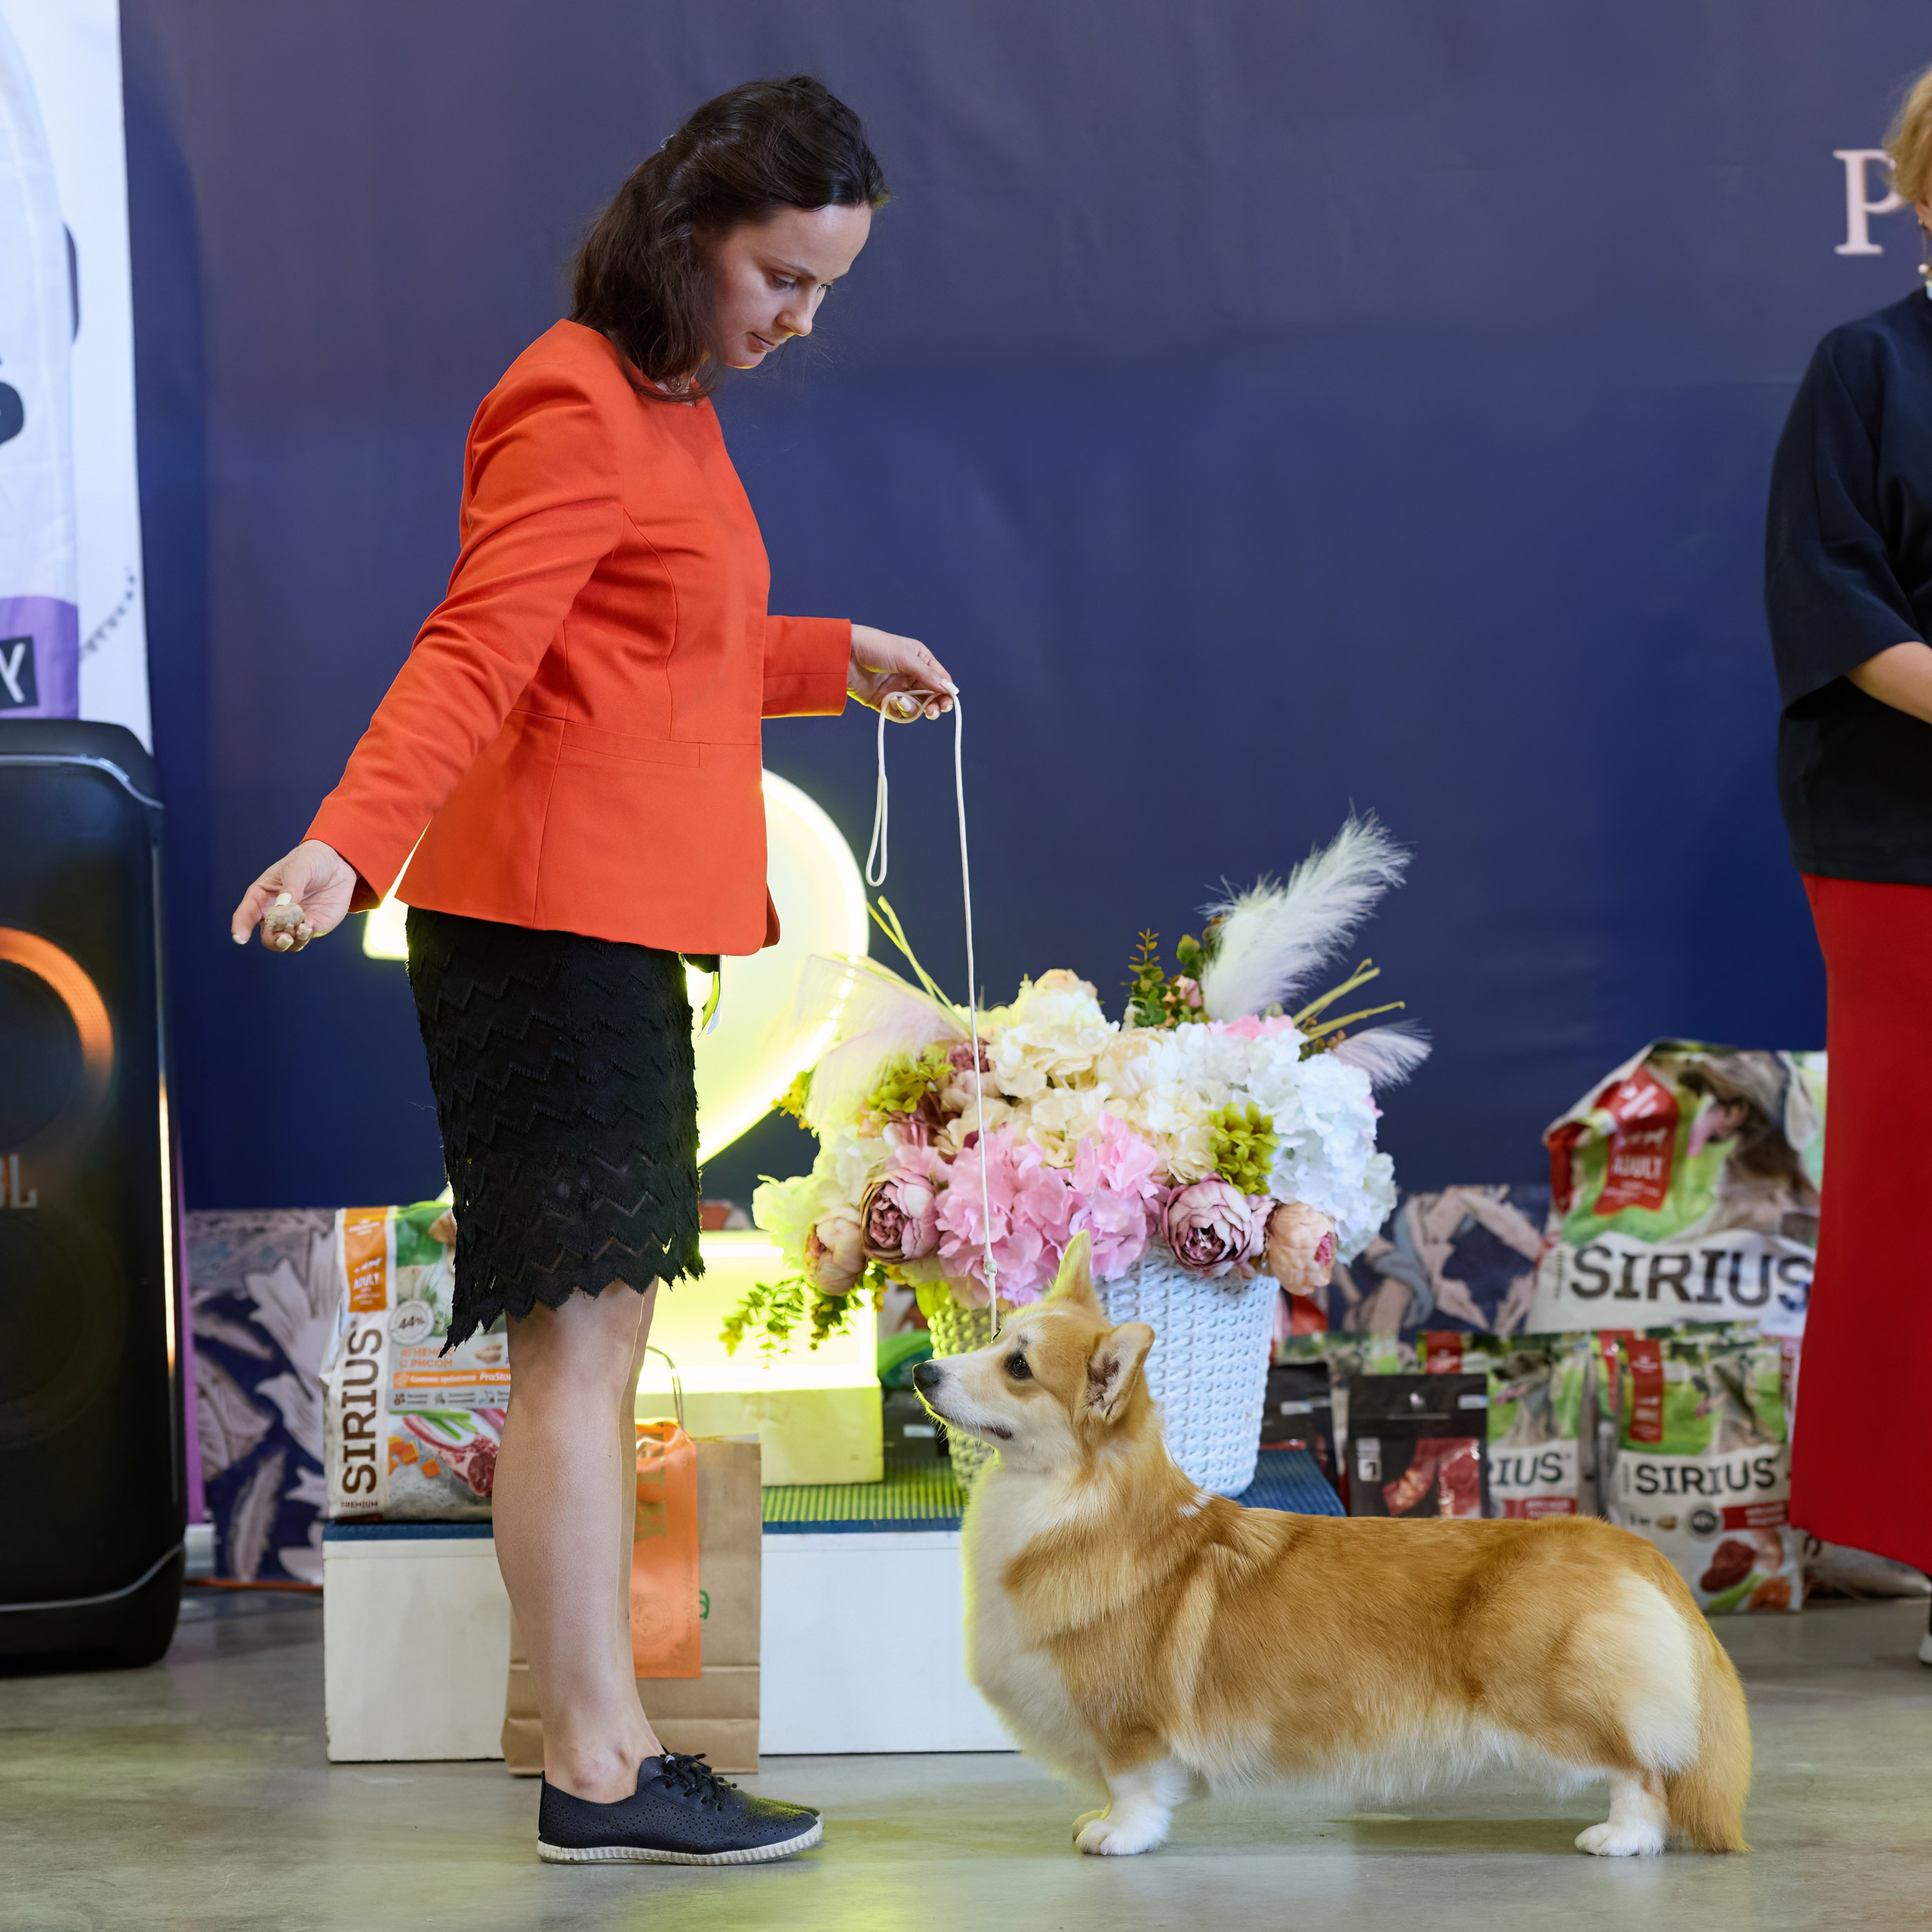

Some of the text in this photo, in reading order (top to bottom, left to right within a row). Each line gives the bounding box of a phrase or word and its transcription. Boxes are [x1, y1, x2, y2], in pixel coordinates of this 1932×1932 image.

[1570, 1245, 1814, 1312] SIRIUS
[341, 1328, 383, 1495] SIRIUS
[1636, 1457, 1775, 1495] SIRIUS
